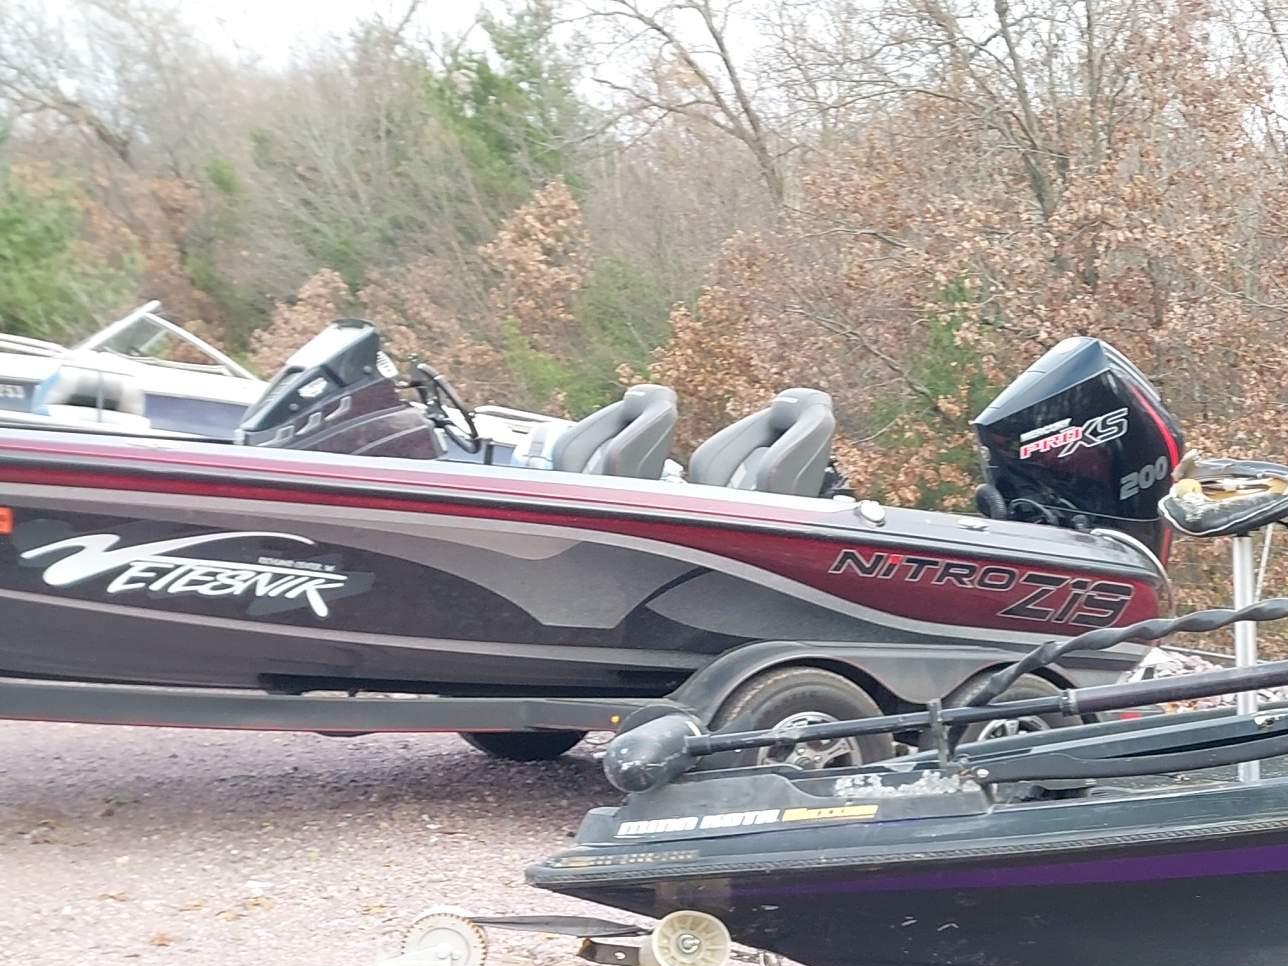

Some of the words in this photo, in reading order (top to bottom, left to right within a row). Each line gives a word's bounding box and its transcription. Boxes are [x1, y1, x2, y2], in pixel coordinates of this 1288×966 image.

[1119, 455, 1170, 501] 200
[828, 549, 1019, 592] NITRO
[997, 572, 1136, 629] Z19
